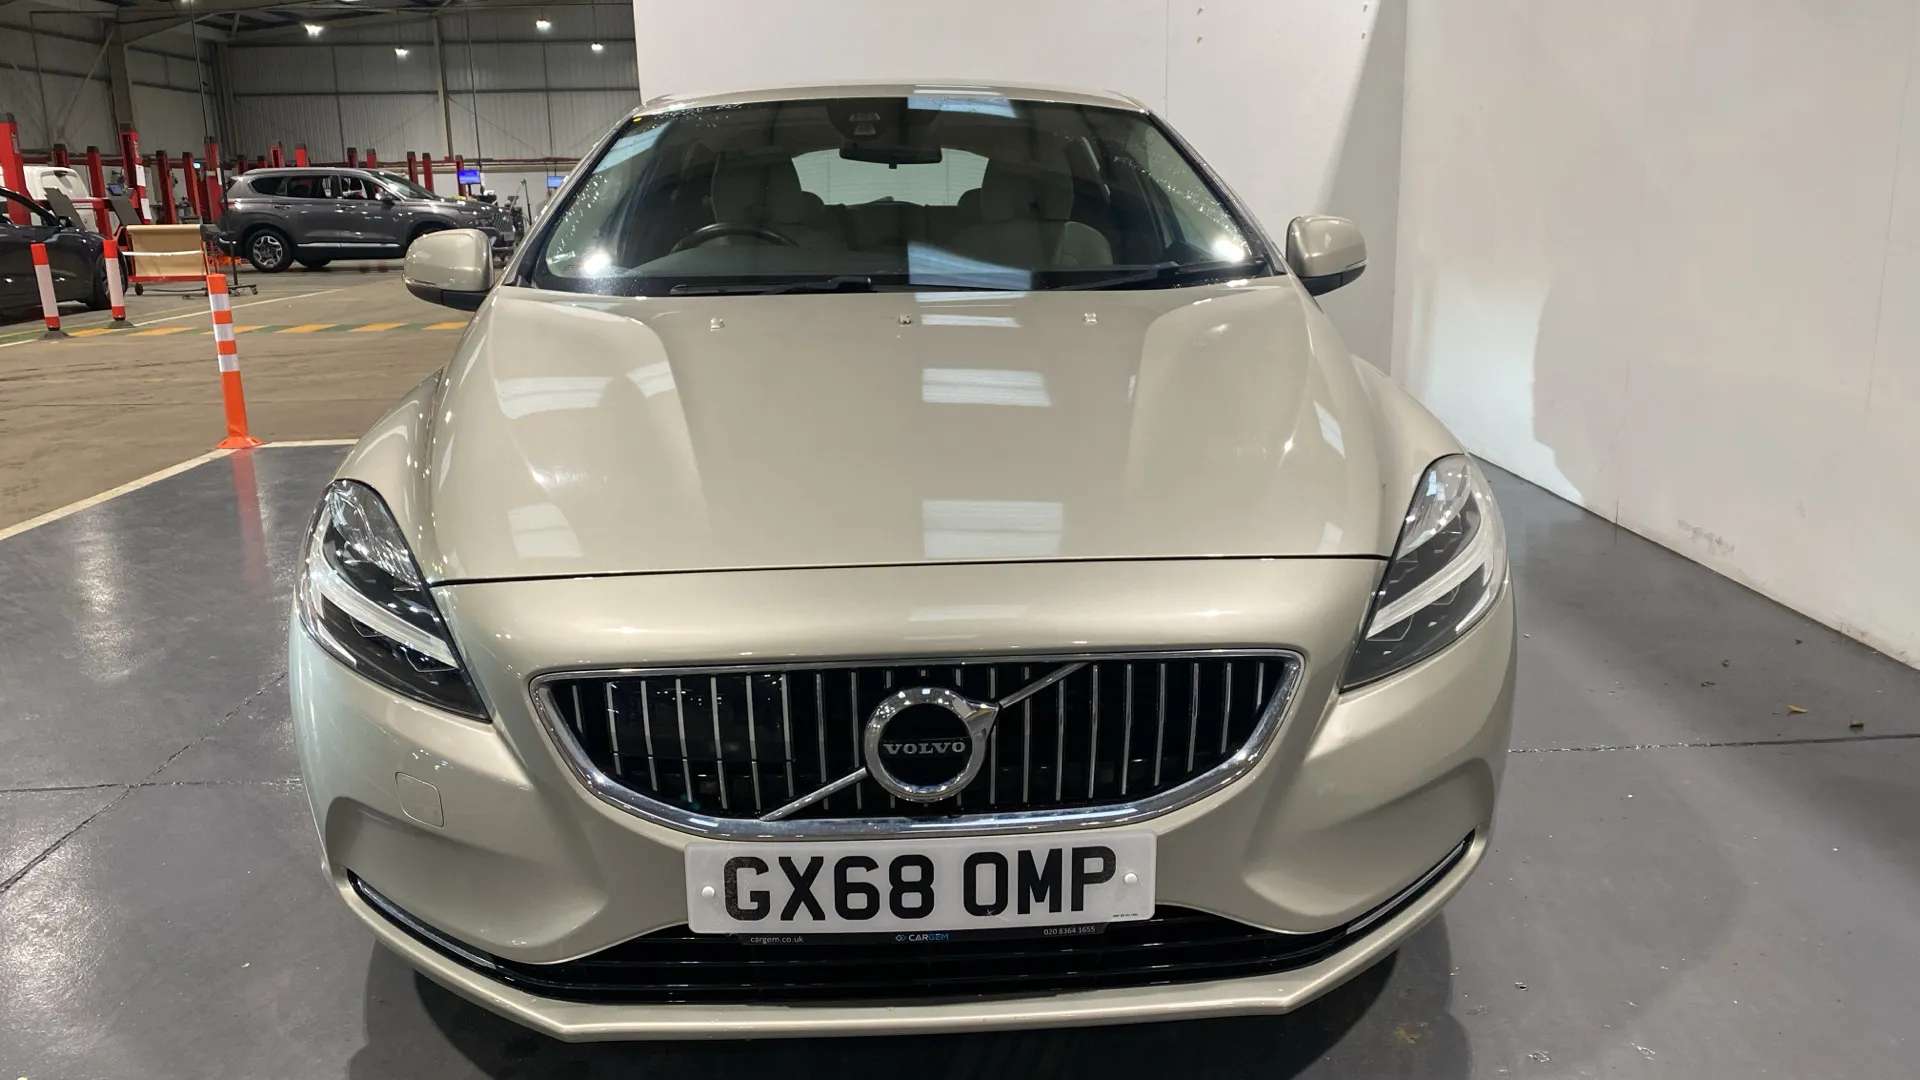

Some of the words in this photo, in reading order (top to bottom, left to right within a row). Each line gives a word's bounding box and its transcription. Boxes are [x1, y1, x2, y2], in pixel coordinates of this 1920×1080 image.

[883, 741, 966, 755] VOLVO
[724, 855, 934, 921] GX68
[963, 846, 1116, 917] OMP
[1043, 928, 1057, 936] 020
[750, 935, 803, 945] cargem.co.uk
[908, 933, 949, 942] CARGEM
